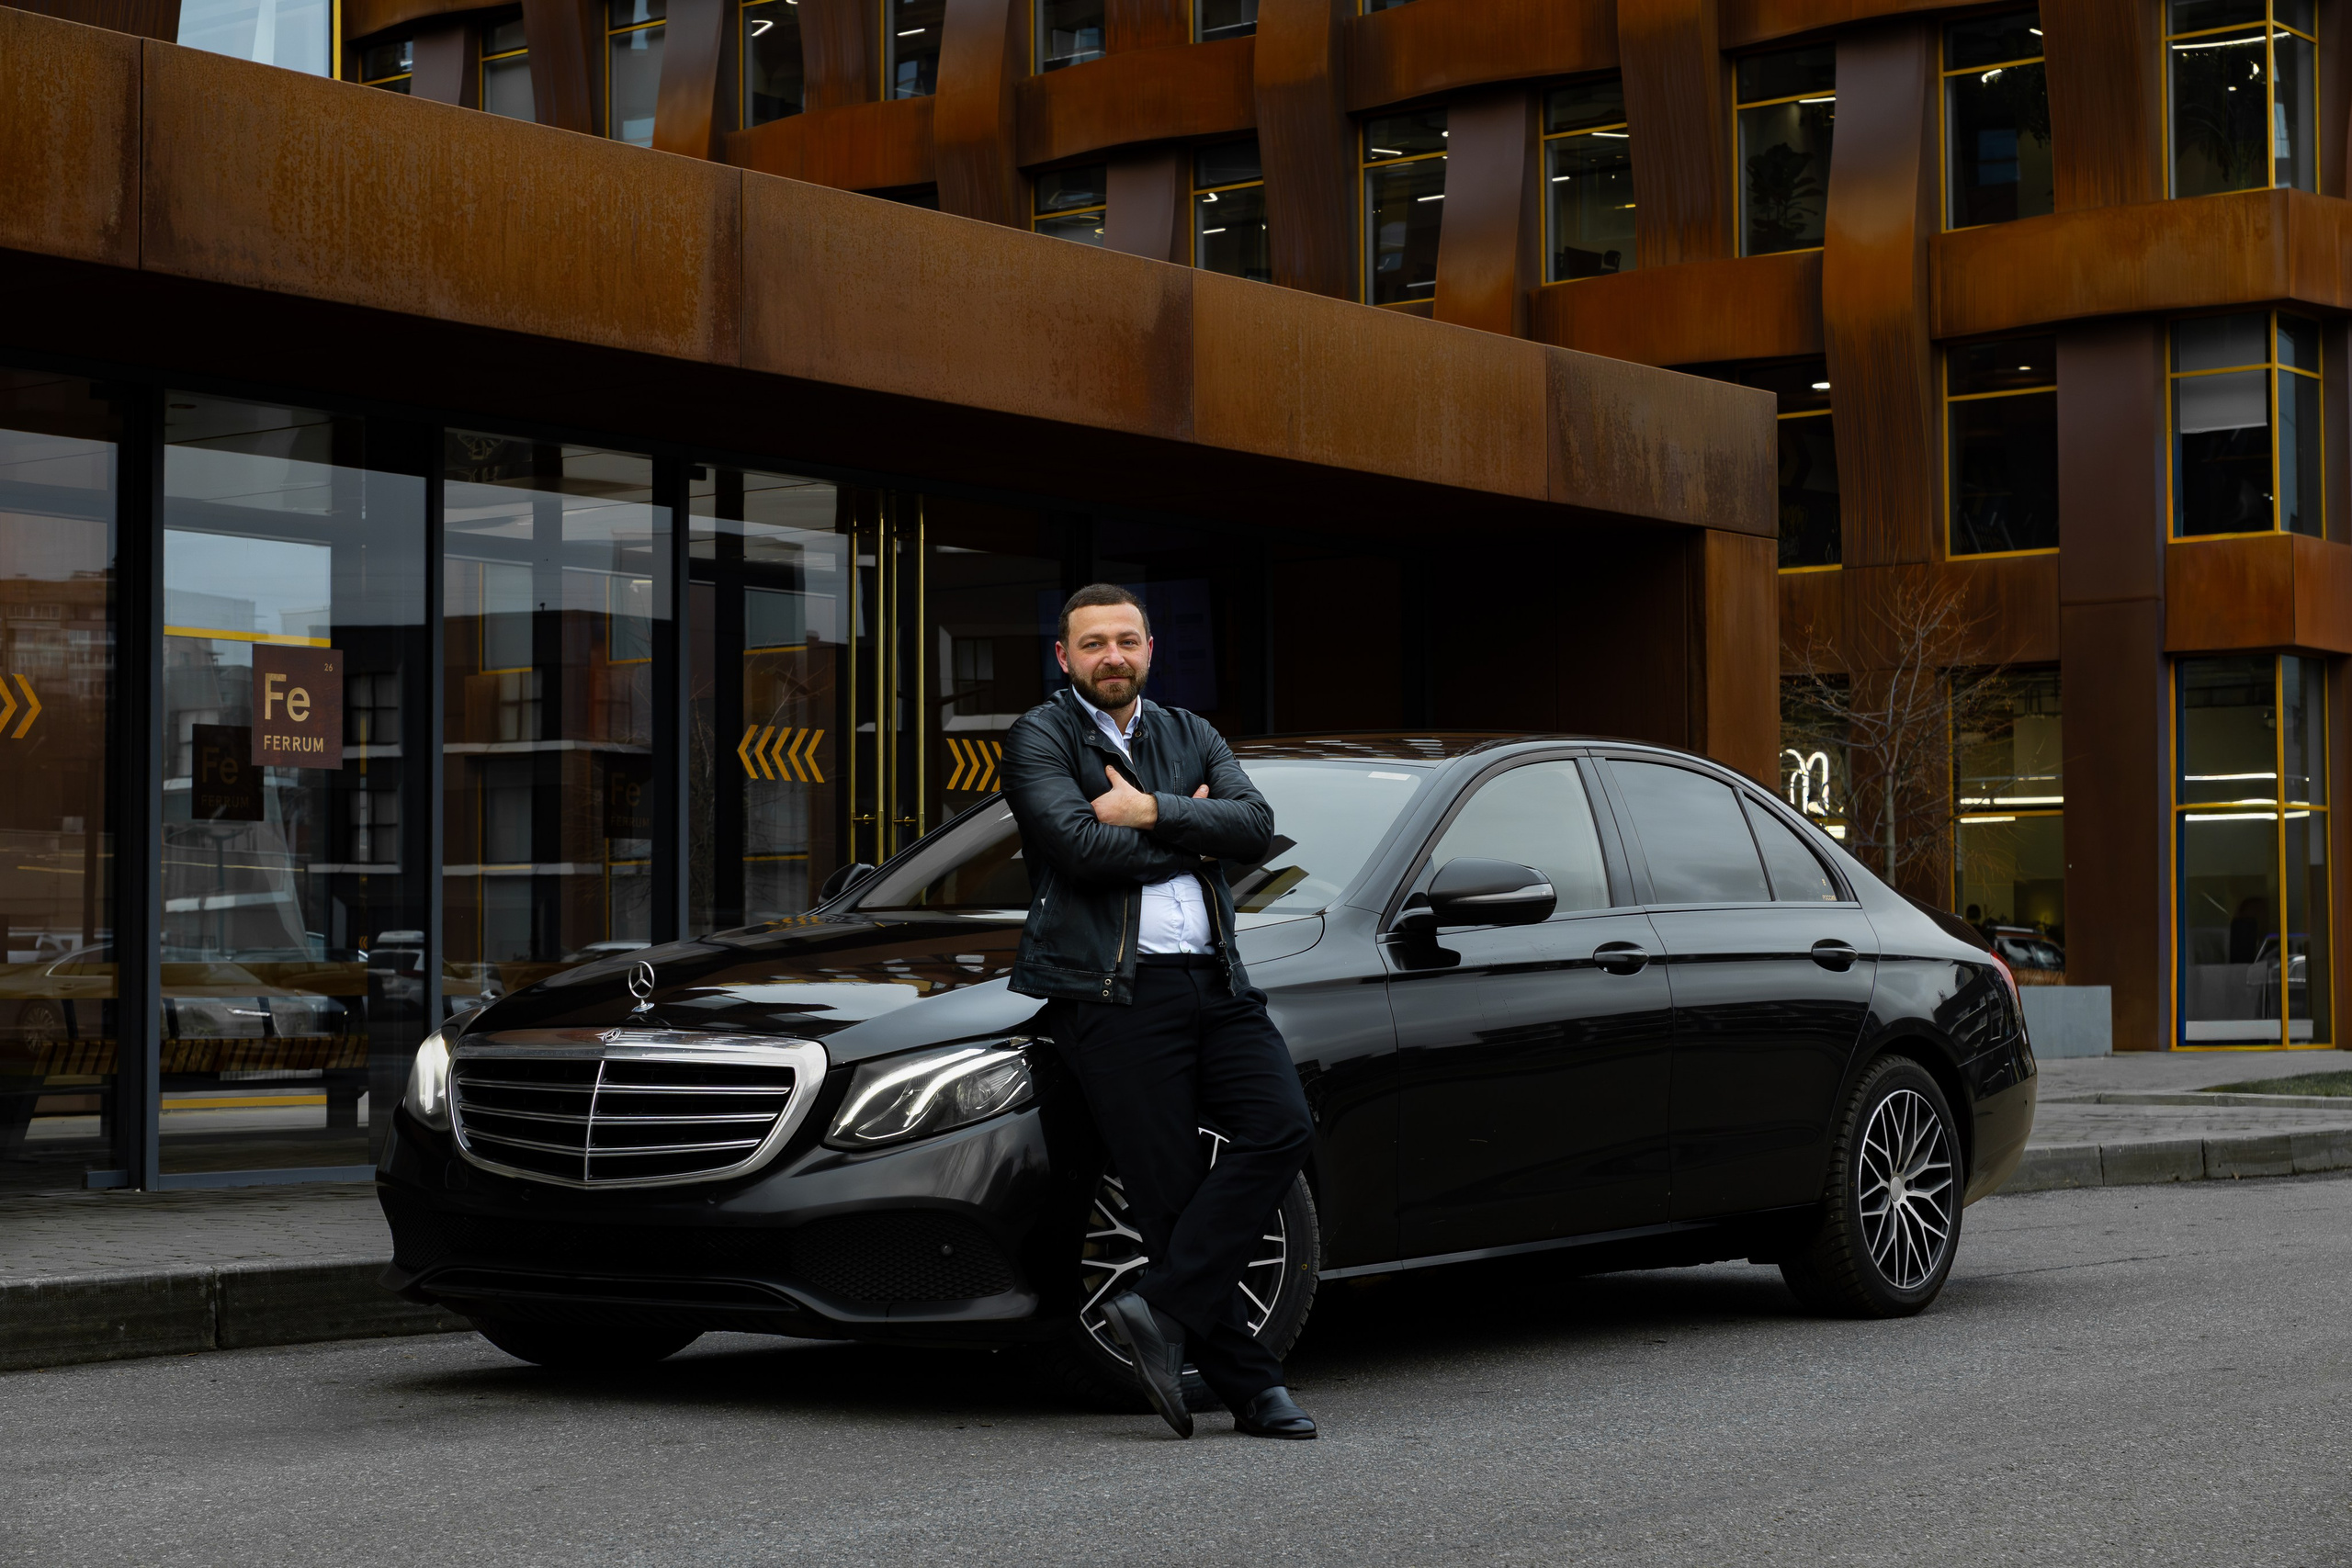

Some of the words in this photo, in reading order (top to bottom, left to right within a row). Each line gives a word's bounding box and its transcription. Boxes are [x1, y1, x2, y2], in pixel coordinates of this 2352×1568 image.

[324, 663, 334, 671] 26
[264, 672, 311, 722] Fe
[264, 735, 324, 752] FERRUM
[202, 747, 239, 785] Fe
[201, 795, 250, 808] FERRUM
[610, 772, 641, 807] Fe
